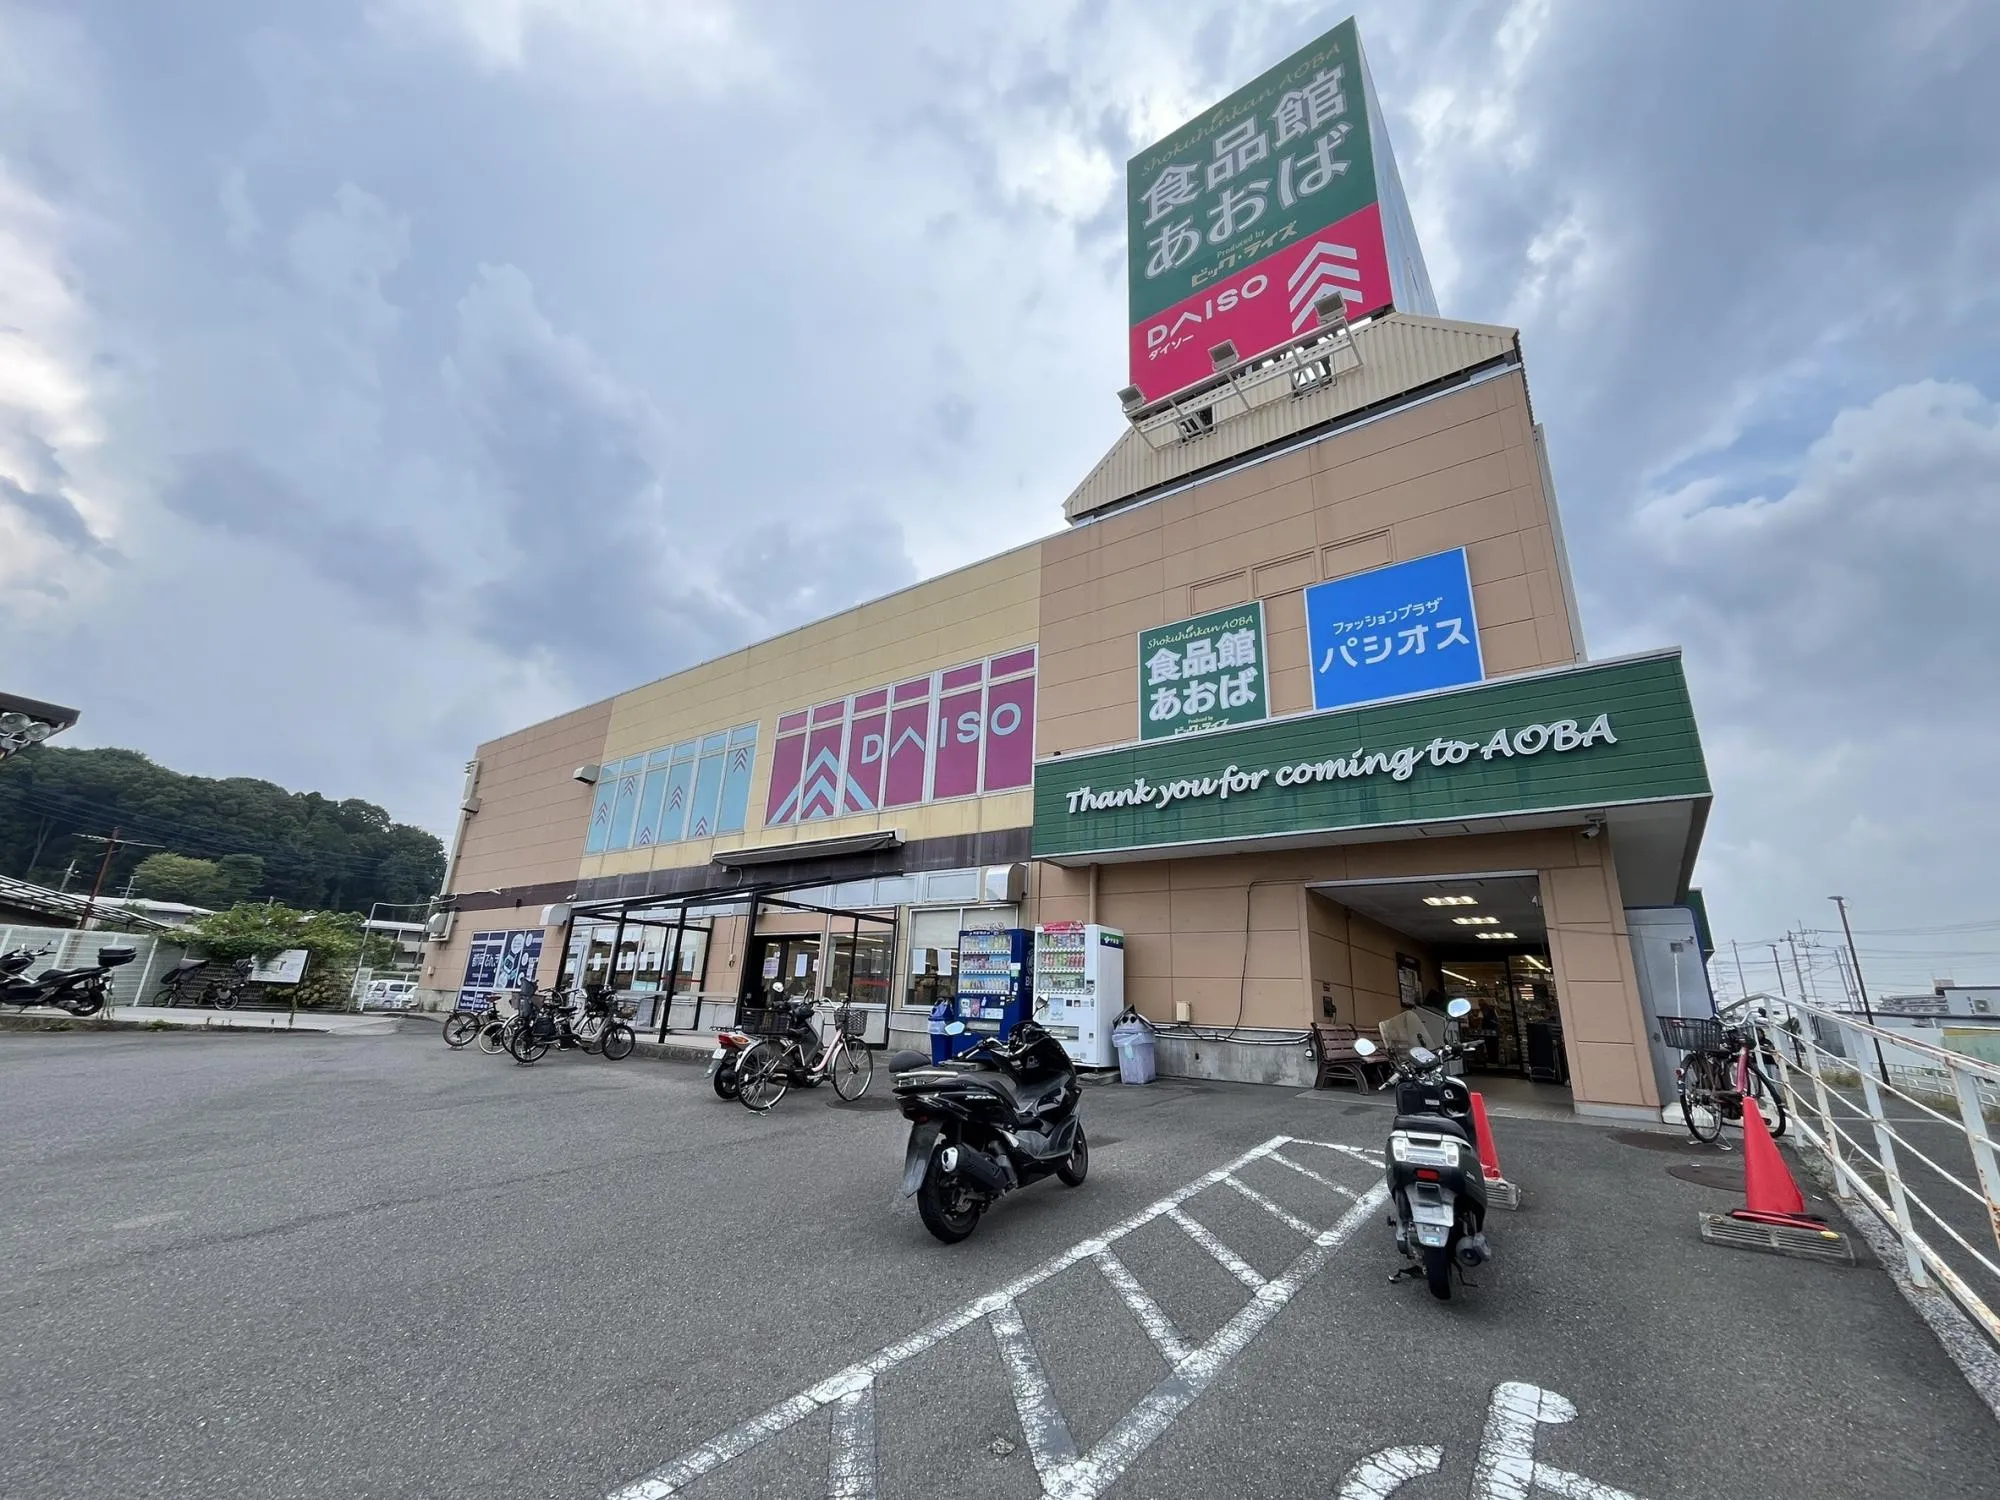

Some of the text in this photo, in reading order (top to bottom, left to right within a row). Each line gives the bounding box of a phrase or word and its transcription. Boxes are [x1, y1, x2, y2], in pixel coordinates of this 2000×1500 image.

[1141, 41, 1341, 177] Shokuhinkan AOBA
[1140, 64, 1345, 228] 食品館
[1146, 122, 1352, 279] あおば
[1216, 229, 1266, 258] Produced by
[1147, 274, 1268, 349] DAISO
[1149, 334, 1194, 361] ダイソー
[1147, 615, 1254, 649] Shokuhinkan AOBA
[1319, 617, 1470, 674] パシオス
[1333, 596, 1443, 635] ファッションプラザ
[1145, 627, 1256, 687] 食品館
[1148, 666, 1258, 721] あおば
[860, 702, 1022, 766] DAISO
[1066, 713, 1618, 814] Thank you for coming to AOBA
